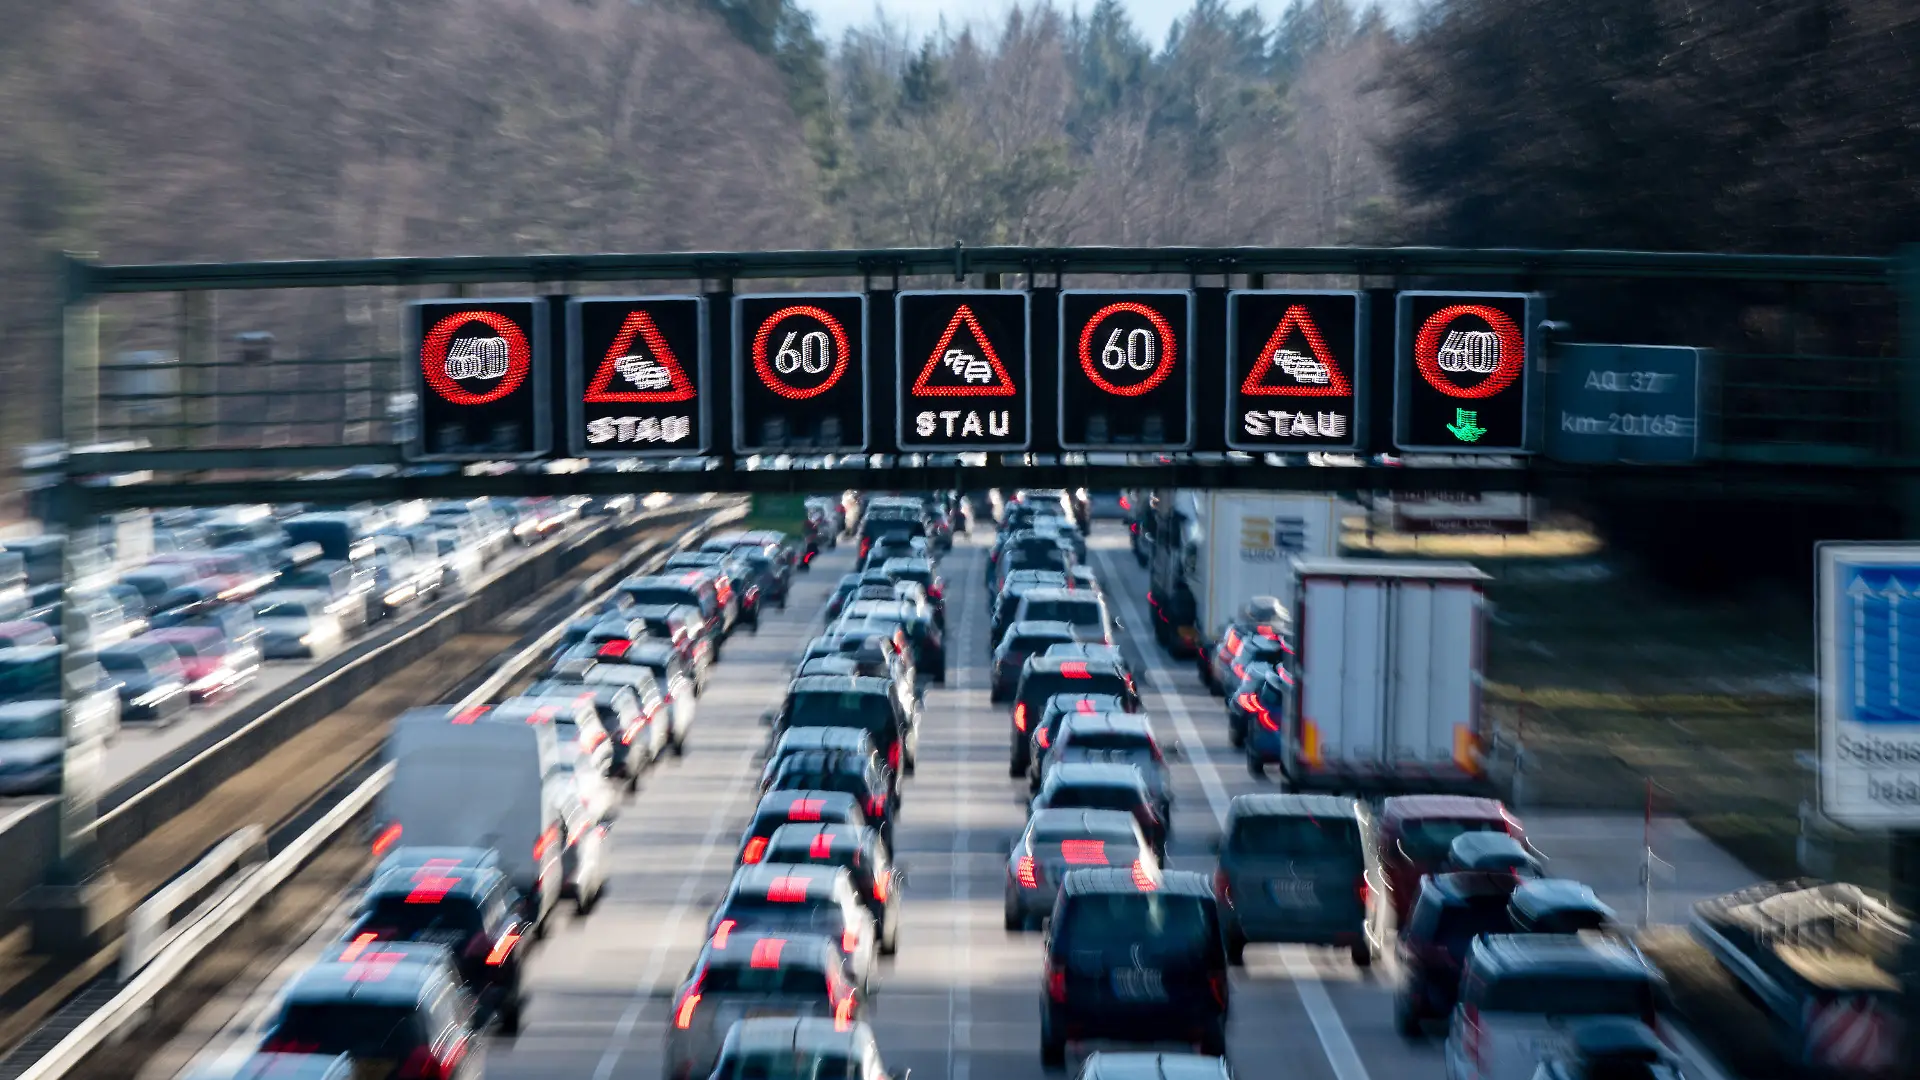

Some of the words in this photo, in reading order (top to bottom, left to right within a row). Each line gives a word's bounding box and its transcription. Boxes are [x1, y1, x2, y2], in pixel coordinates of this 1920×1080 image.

[444, 336, 509, 379] 60
[775, 331, 830, 374] 60
[1101, 327, 1155, 371] 60
[1438, 330, 1502, 373] 60
[1584, 369, 1620, 391] AQ
[1630, 370, 1664, 392] 37
[587, 415, 690, 443] STAU
[916, 409, 1010, 437] STAU
[1244, 409, 1347, 437] STAU
[1561, 410, 1599, 434] km
